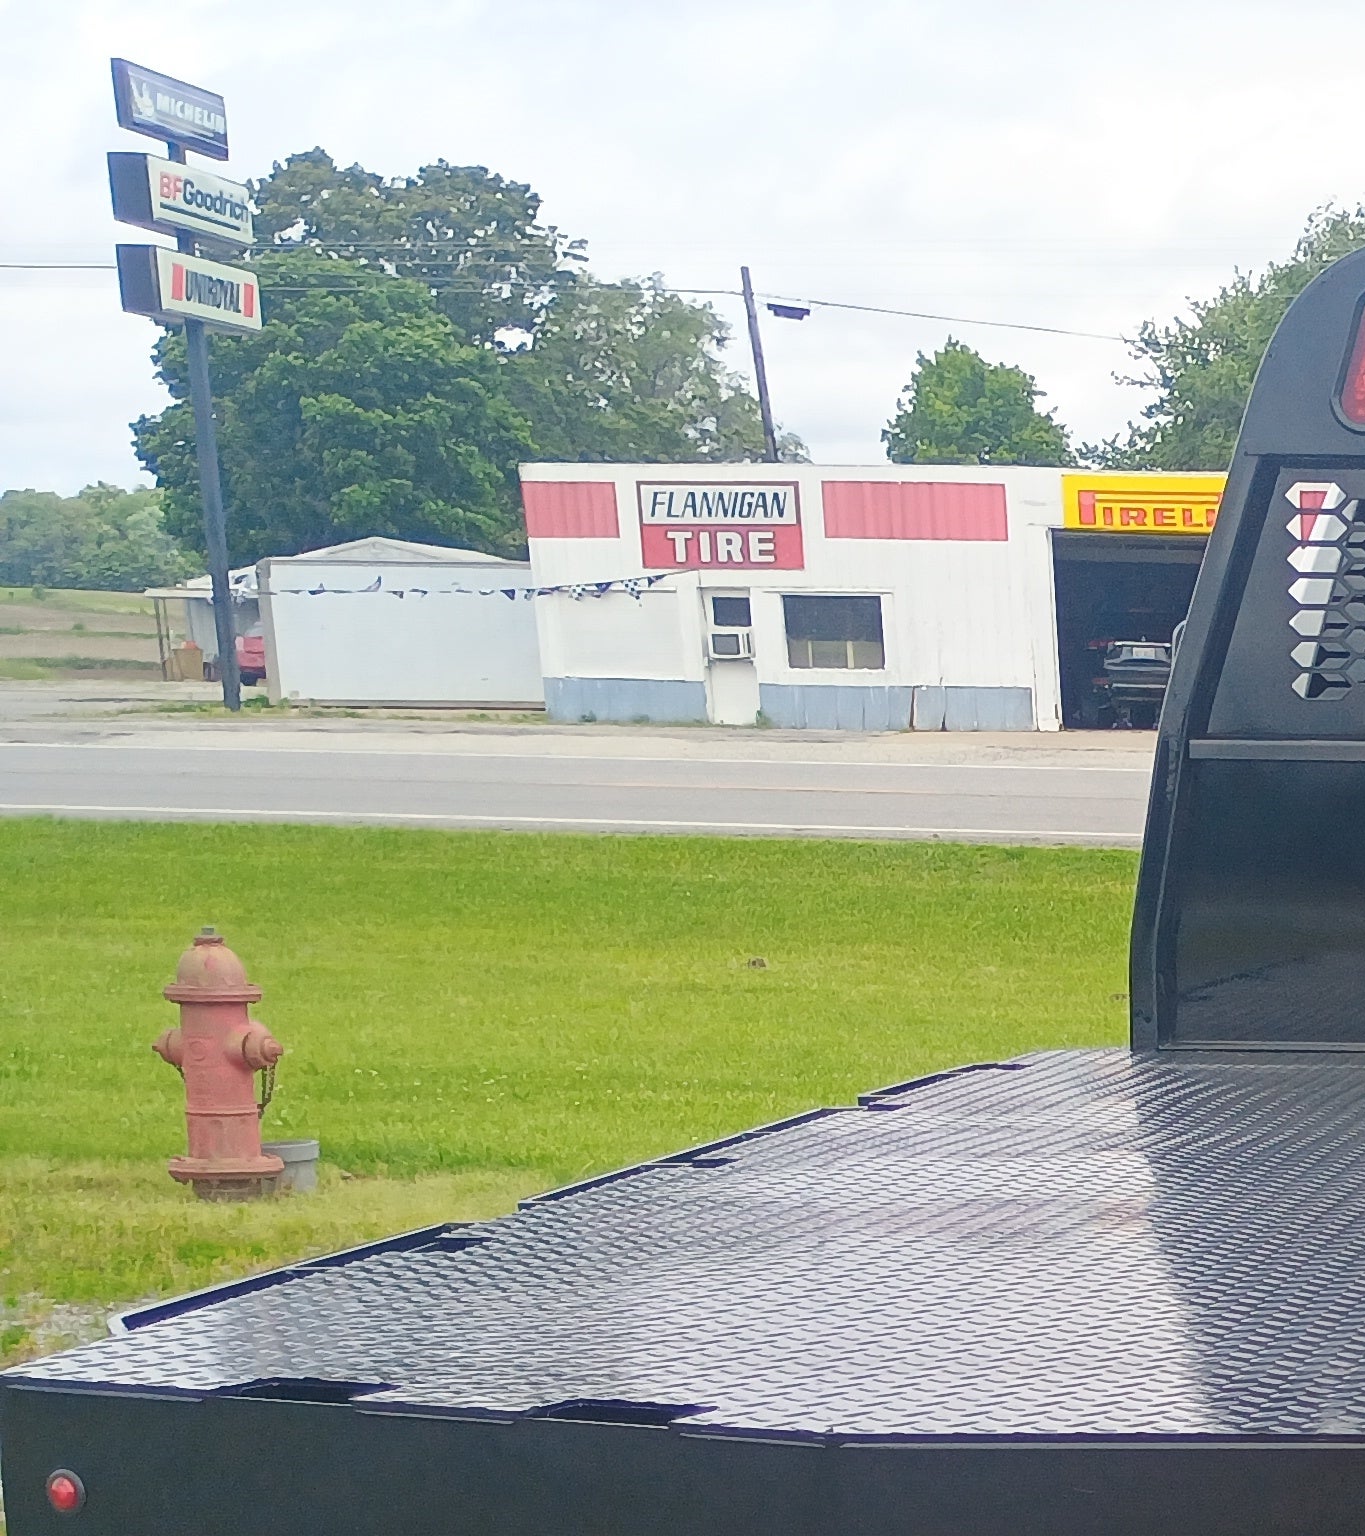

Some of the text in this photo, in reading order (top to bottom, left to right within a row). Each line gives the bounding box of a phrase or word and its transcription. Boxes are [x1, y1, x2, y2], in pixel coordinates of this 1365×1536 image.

[157, 93, 225, 134] MICHELIN
[160, 172, 249, 222] BFGoodrich
[650, 491, 787, 518] FLANNIGAN
[666, 531, 776, 563] TIRE
